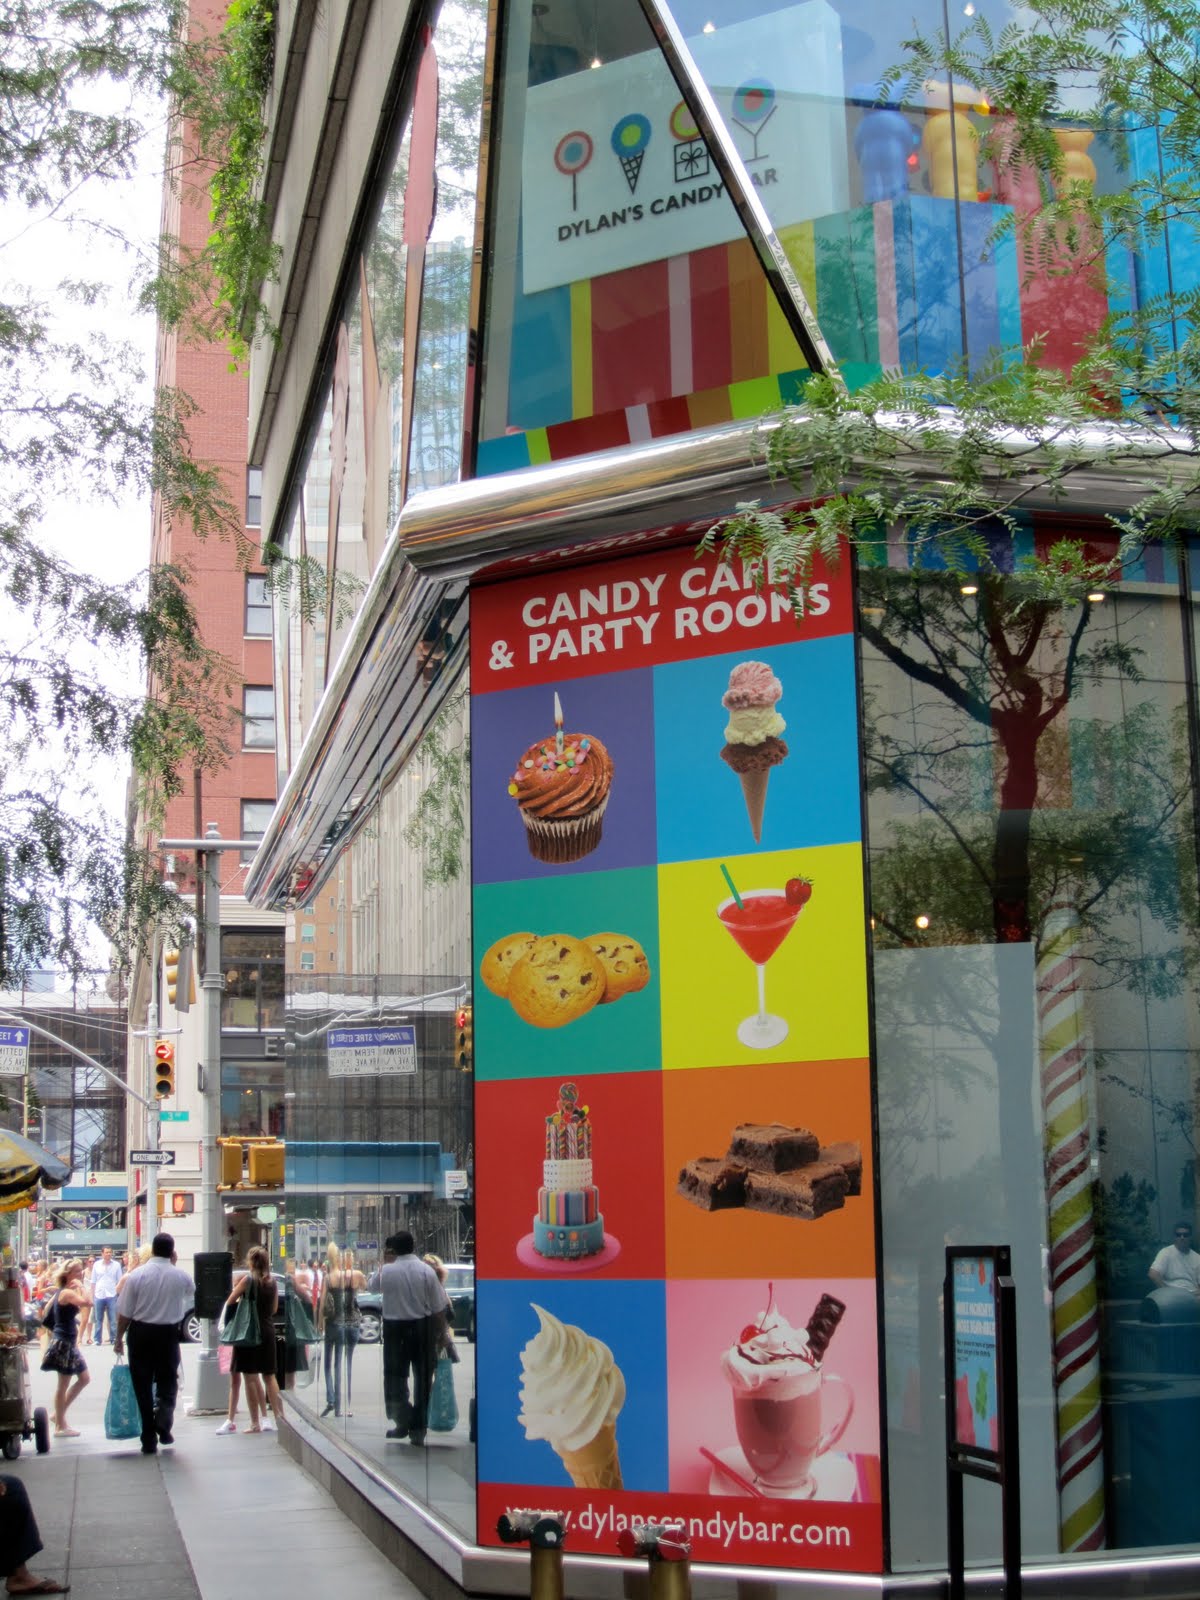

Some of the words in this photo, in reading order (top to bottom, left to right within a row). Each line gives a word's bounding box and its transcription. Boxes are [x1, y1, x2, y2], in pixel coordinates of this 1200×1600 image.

[558, 204, 644, 241] DYLAN'S
[650, 181, 724, 215] CANDY
[488, 640, 514, 671] &
[528, 612, 660, 665] PARTY
[675, 583, 831, 639] ROOMS
[522, 573, 667, 628] CANDY
[505, 1503, 851, 1547] .dylanscandybar.com
